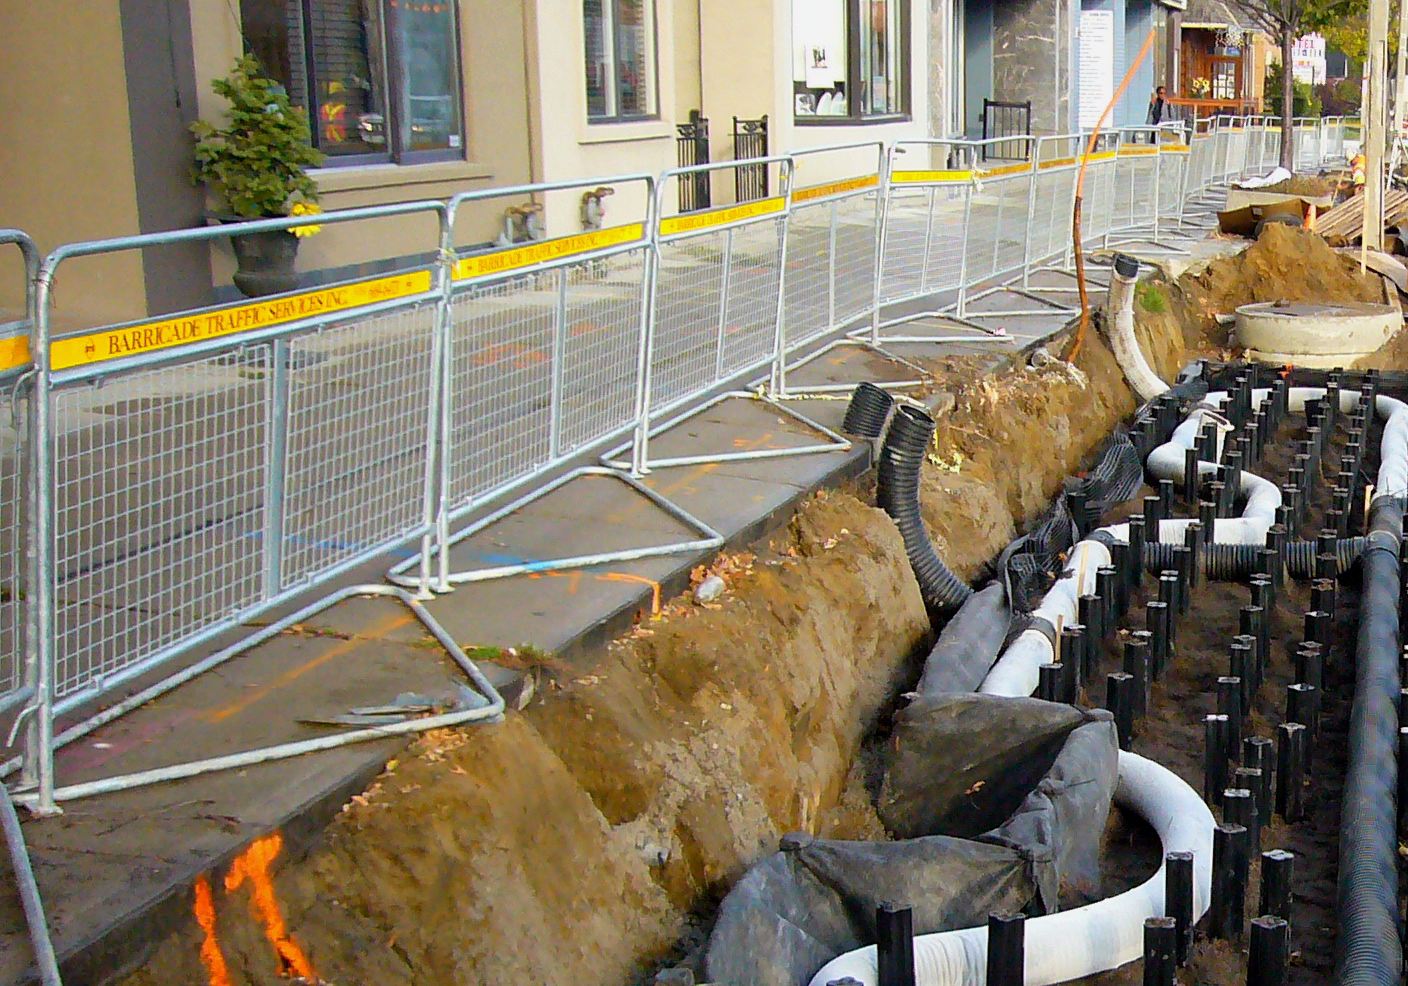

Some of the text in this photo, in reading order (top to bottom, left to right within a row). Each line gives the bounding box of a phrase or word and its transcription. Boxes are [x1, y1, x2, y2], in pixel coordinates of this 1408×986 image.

[108, 319, 200, 354] BARRICADE
[206, 305, 265, 334] TRAFFIC
[268, 294, 323, 321] SERVICES
